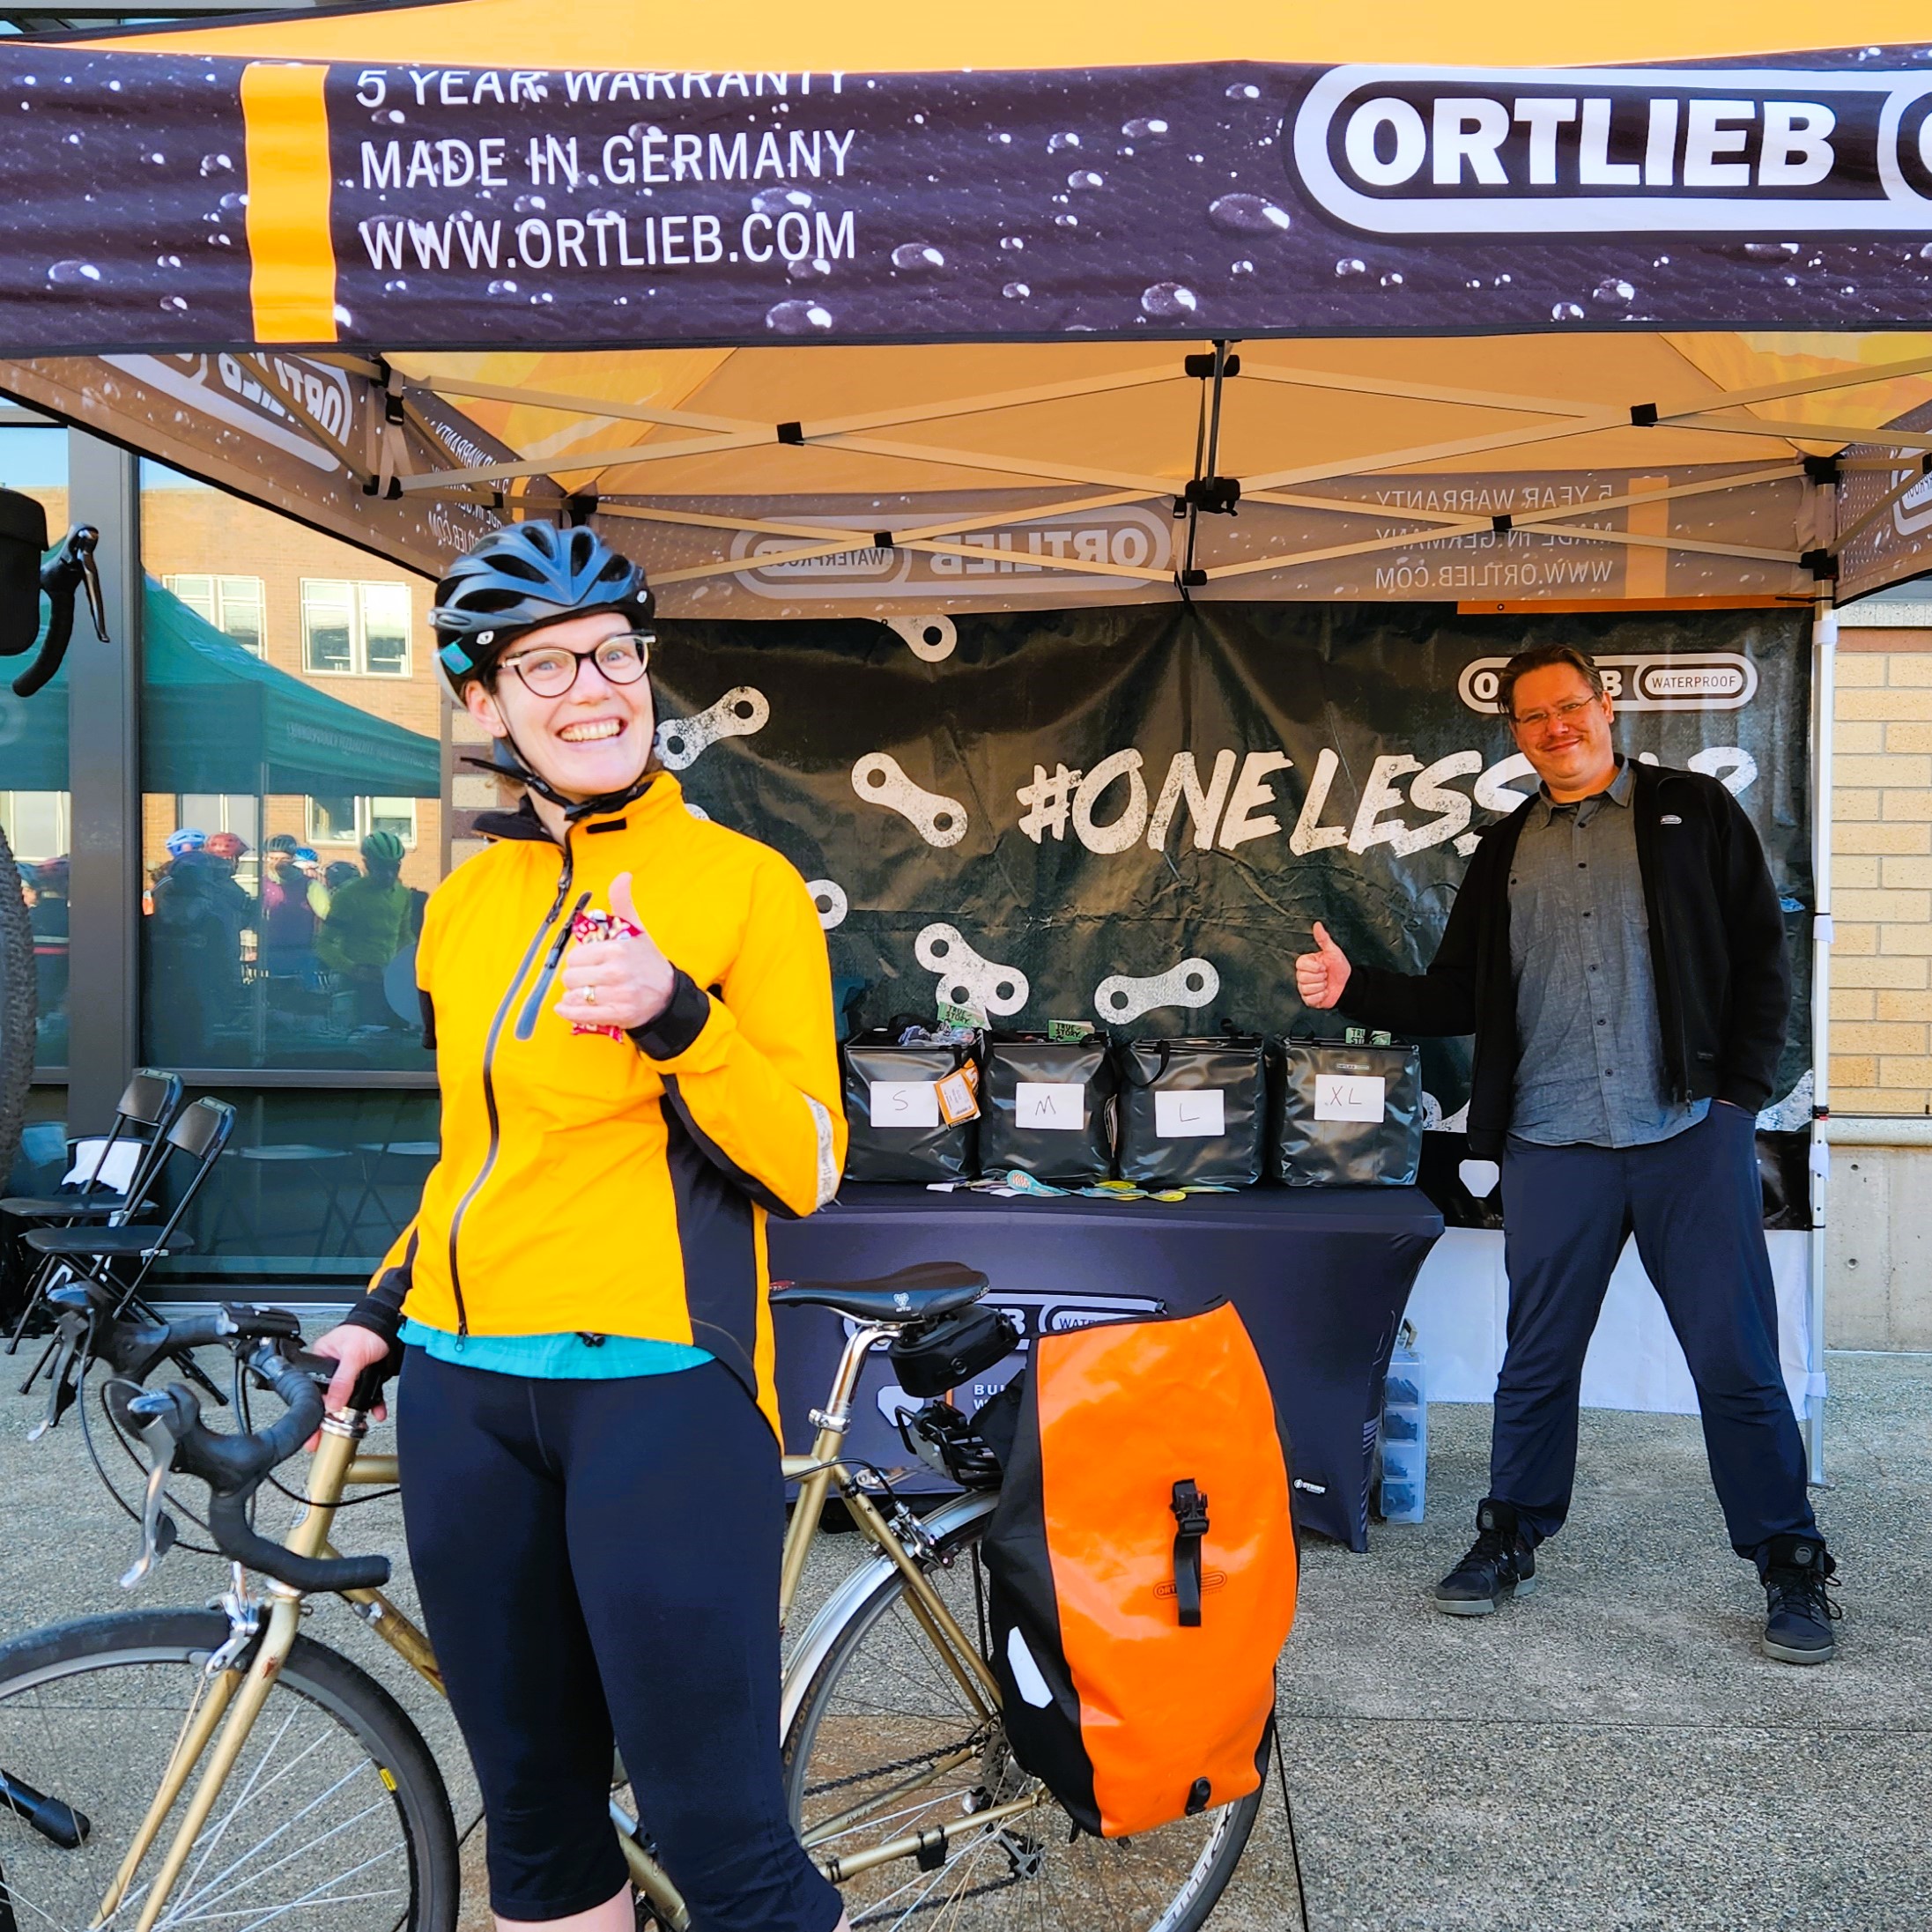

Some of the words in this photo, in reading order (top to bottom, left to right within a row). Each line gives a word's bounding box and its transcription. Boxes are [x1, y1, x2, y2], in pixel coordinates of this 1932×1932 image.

[355, 70, 387, 107] 5
[410, 70, 544, 105] YEAR
[1345, 97, 1837, 187] ORTLIEB
[360, 137, 507, 189] MADE
[529, 135, 578, 186] IN
[602, 129, 855, 185] GERMANY
[359, 210, 855, 270] WWW.ORTLIEB.COM
[1652, 676, 1736, 689] WATERPROOF
[892, 1090, 908, 1111] S
[1035, 1095, 1055, 1115] M
[1330, 1085, 1362, 1107] XL
[1179, 1102, 1200, 1121] L
